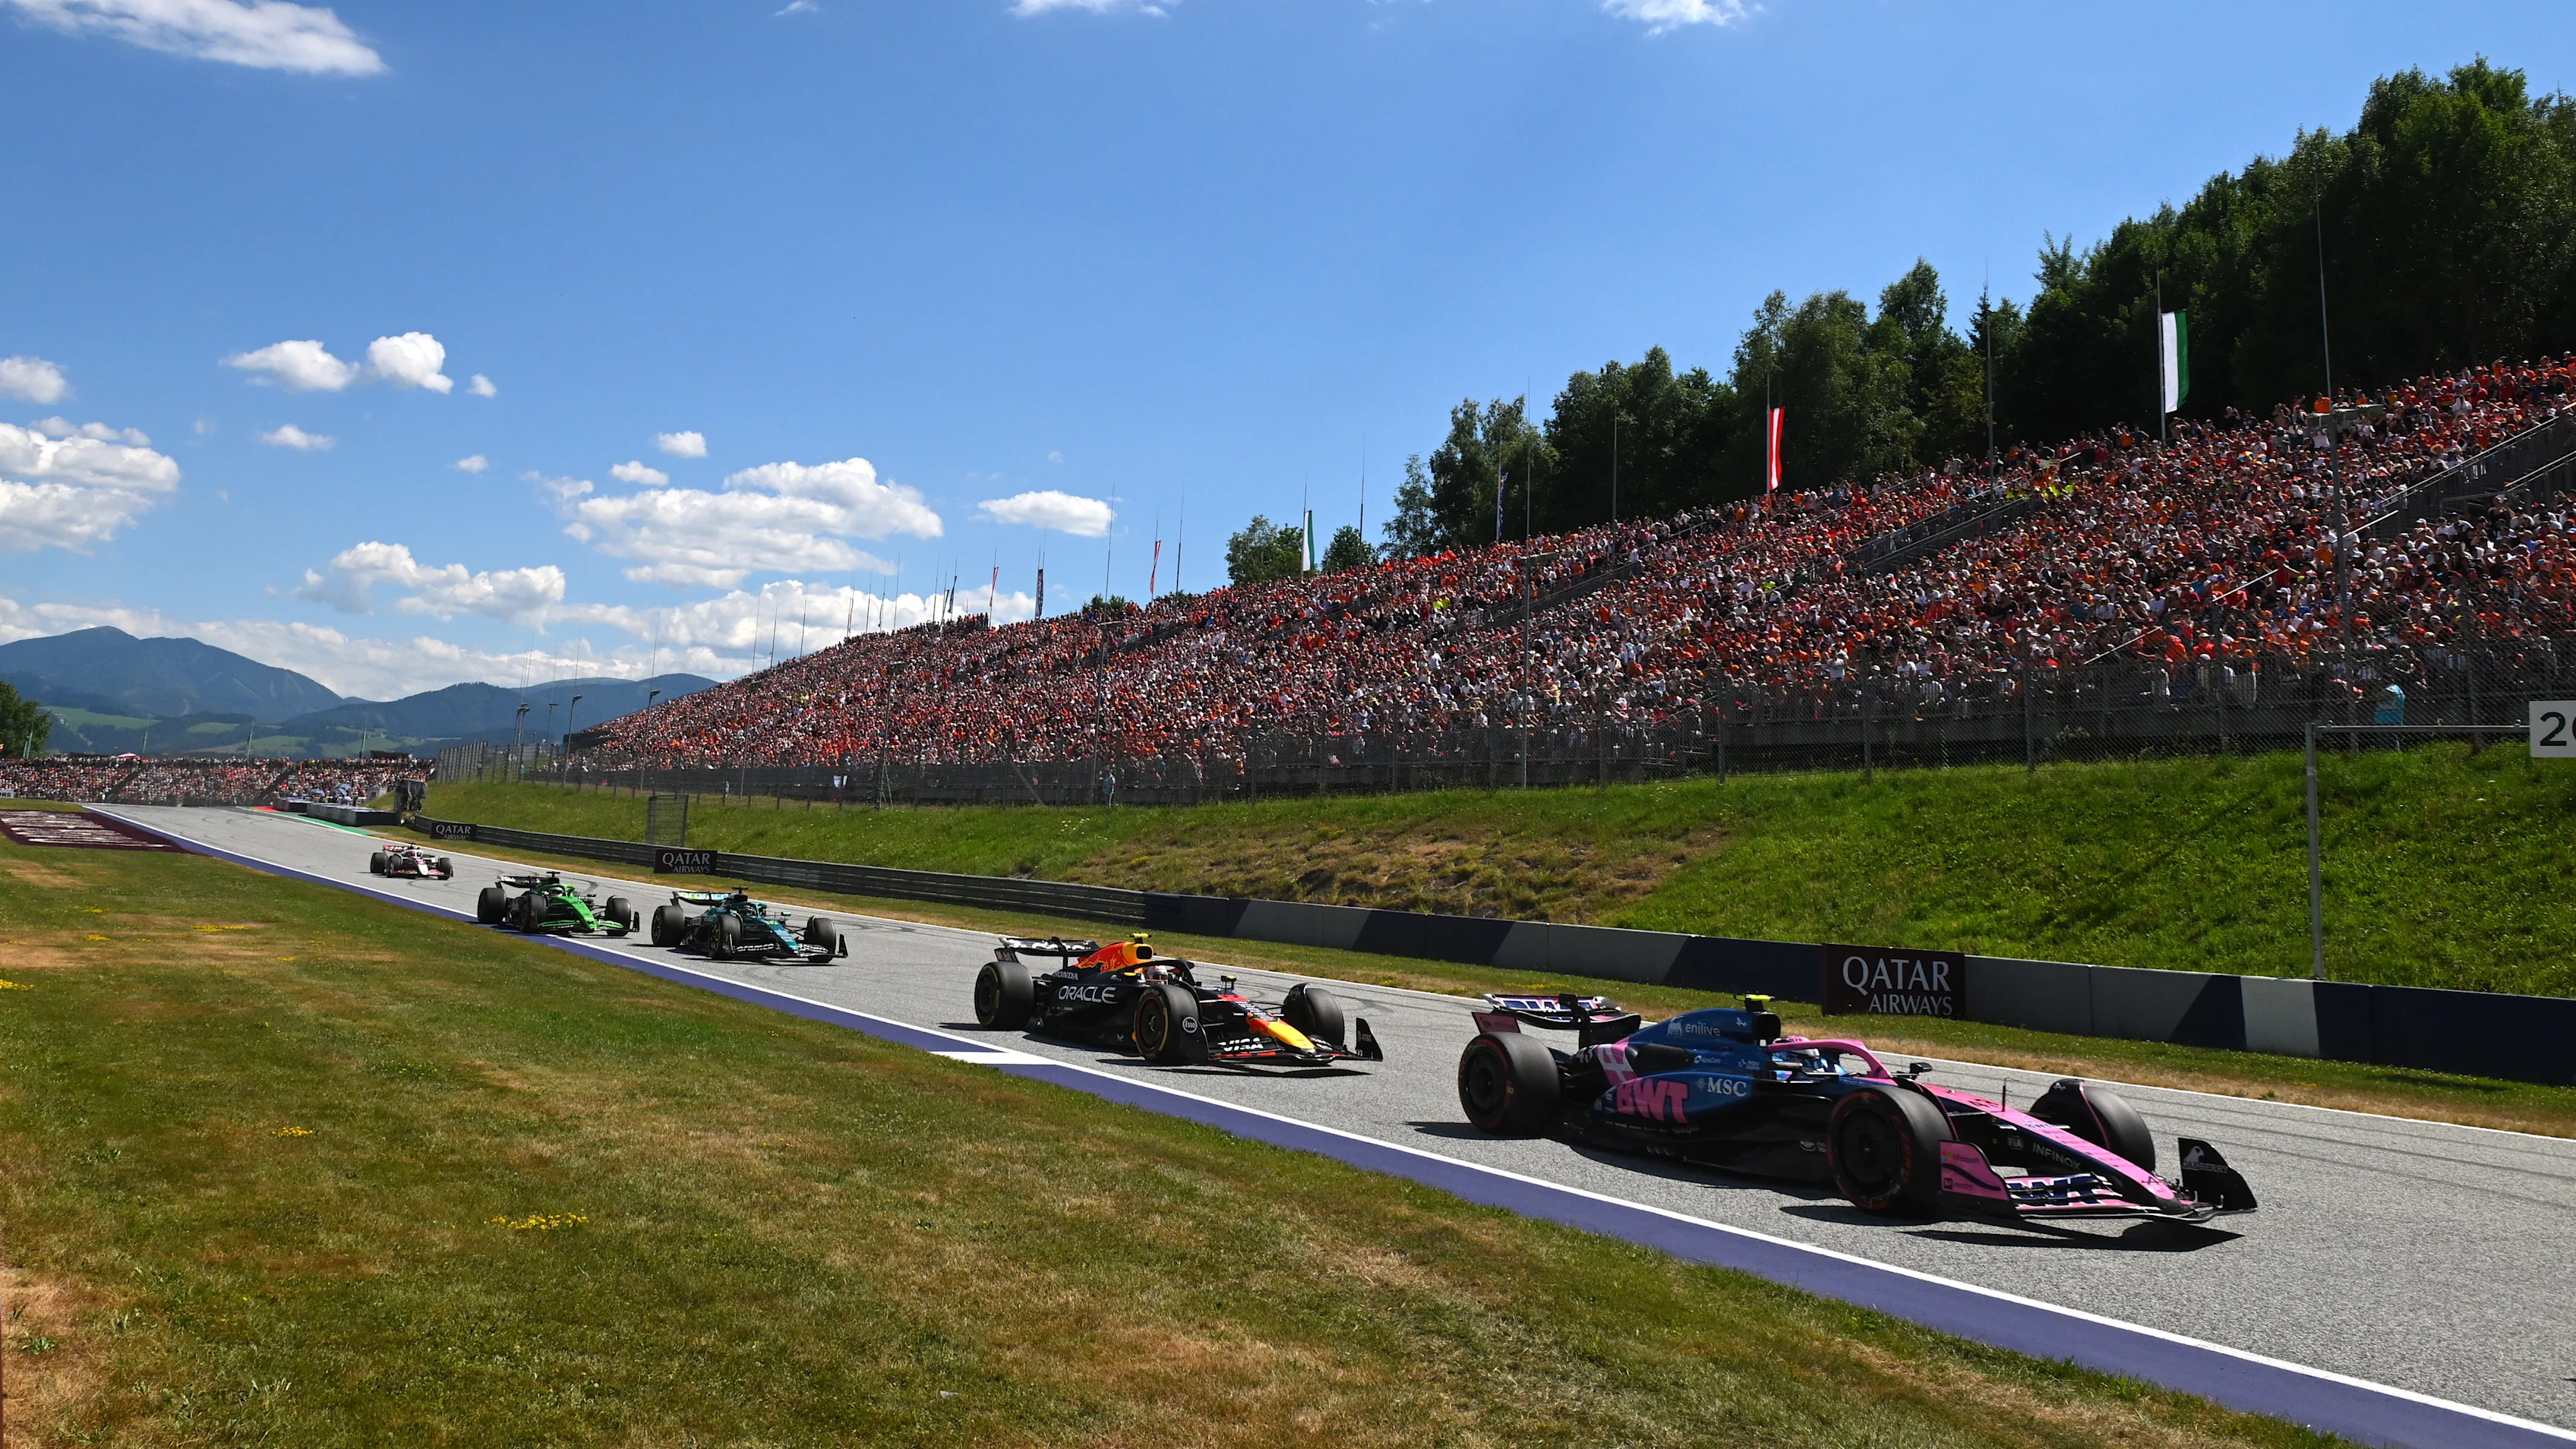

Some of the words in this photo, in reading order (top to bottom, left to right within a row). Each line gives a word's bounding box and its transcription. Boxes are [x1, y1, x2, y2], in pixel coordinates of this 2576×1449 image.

[2540, 712, 2576, 746] 2
[436, 825, 471, 835] QATAR
[662, 852, 710, 867] QATAR
[736, 943, 775, 952] aramco
[996, 950, 1012, 961] Mobil
[1053, 970, 1079, 980] HONDA
[1842, 956, 1951, 996] QATAR
[1058, 986, 1118, 1005] ORACLE
[1869, 994, 1952, 1015] AIRWAYS
[1184, 1020, 1196, 1029] Esso
[1684, 1021, 1722, 1037] enilive
[1217, 1037, 1264, 1052] VISA
[1707, 1077, 1747, 1097] MSC
[1616, 1077, 1689, 1124] BWT
[2032, 1142, 2081, 1171] INFINOX
